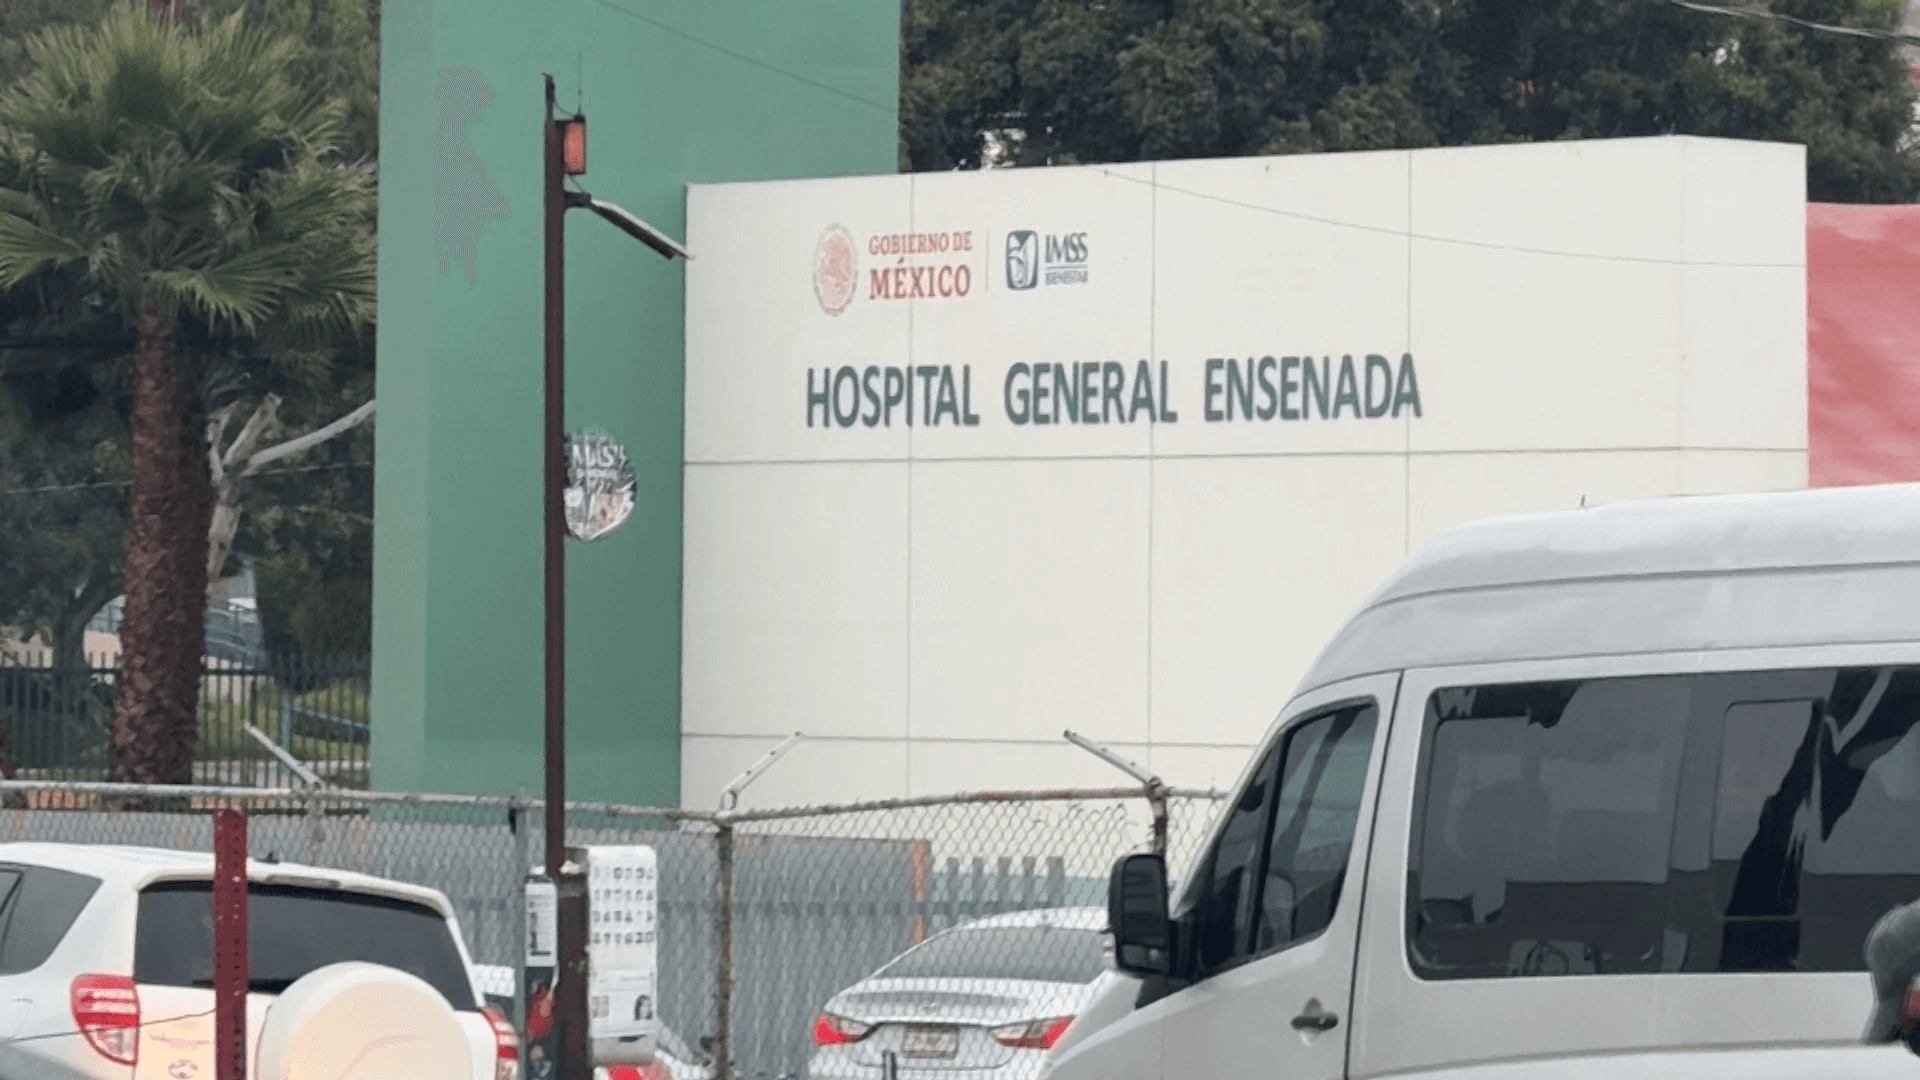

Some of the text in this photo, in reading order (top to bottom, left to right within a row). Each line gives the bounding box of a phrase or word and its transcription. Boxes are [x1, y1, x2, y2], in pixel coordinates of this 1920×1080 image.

[868, 230, 973, 255] GOBIERNO DE
[1044, 232, 1089, 263] IMSS
[868, 256, 971, 300] MÉXICO
[806, 352, 1423, 428] HOSPITAL GENERAL ENSENADA
